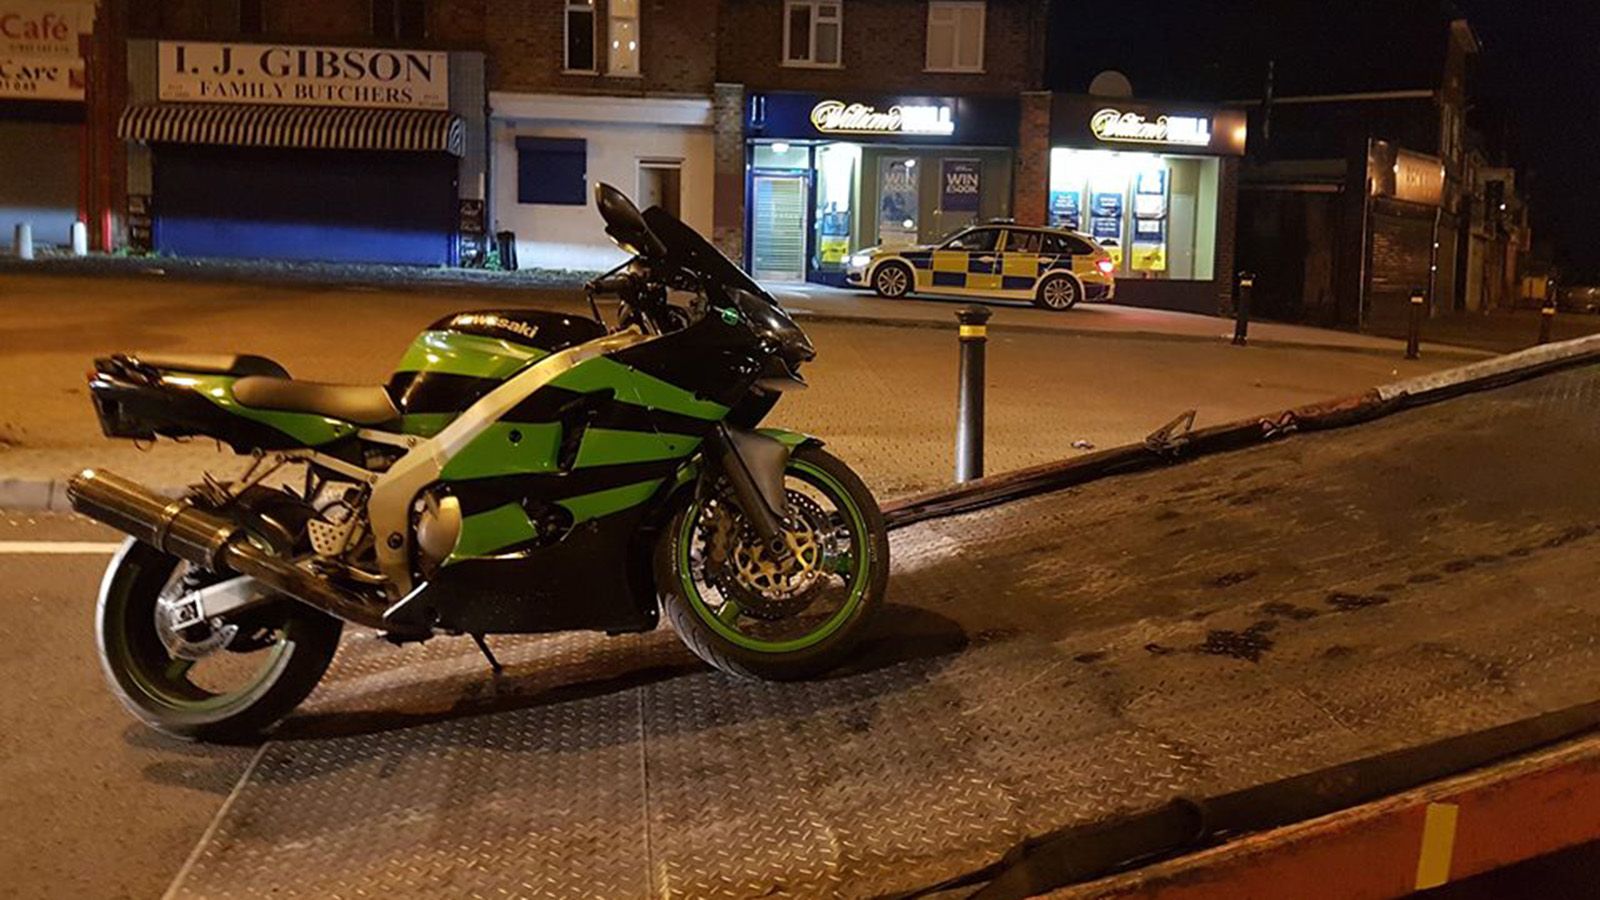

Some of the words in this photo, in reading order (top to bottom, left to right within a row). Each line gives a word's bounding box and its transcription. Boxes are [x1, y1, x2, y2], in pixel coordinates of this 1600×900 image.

[0, 13, 69, 41] Café
[176, 46, 199, 74] I.
[213, 47, 244, 75] J.
[259, 48, 432, 83] GIBSON
[201, 81, 287, 98] FAMILY
[294, 83, 413, 103] BUTCHERS
[946, 174, 979, 185] WIN
